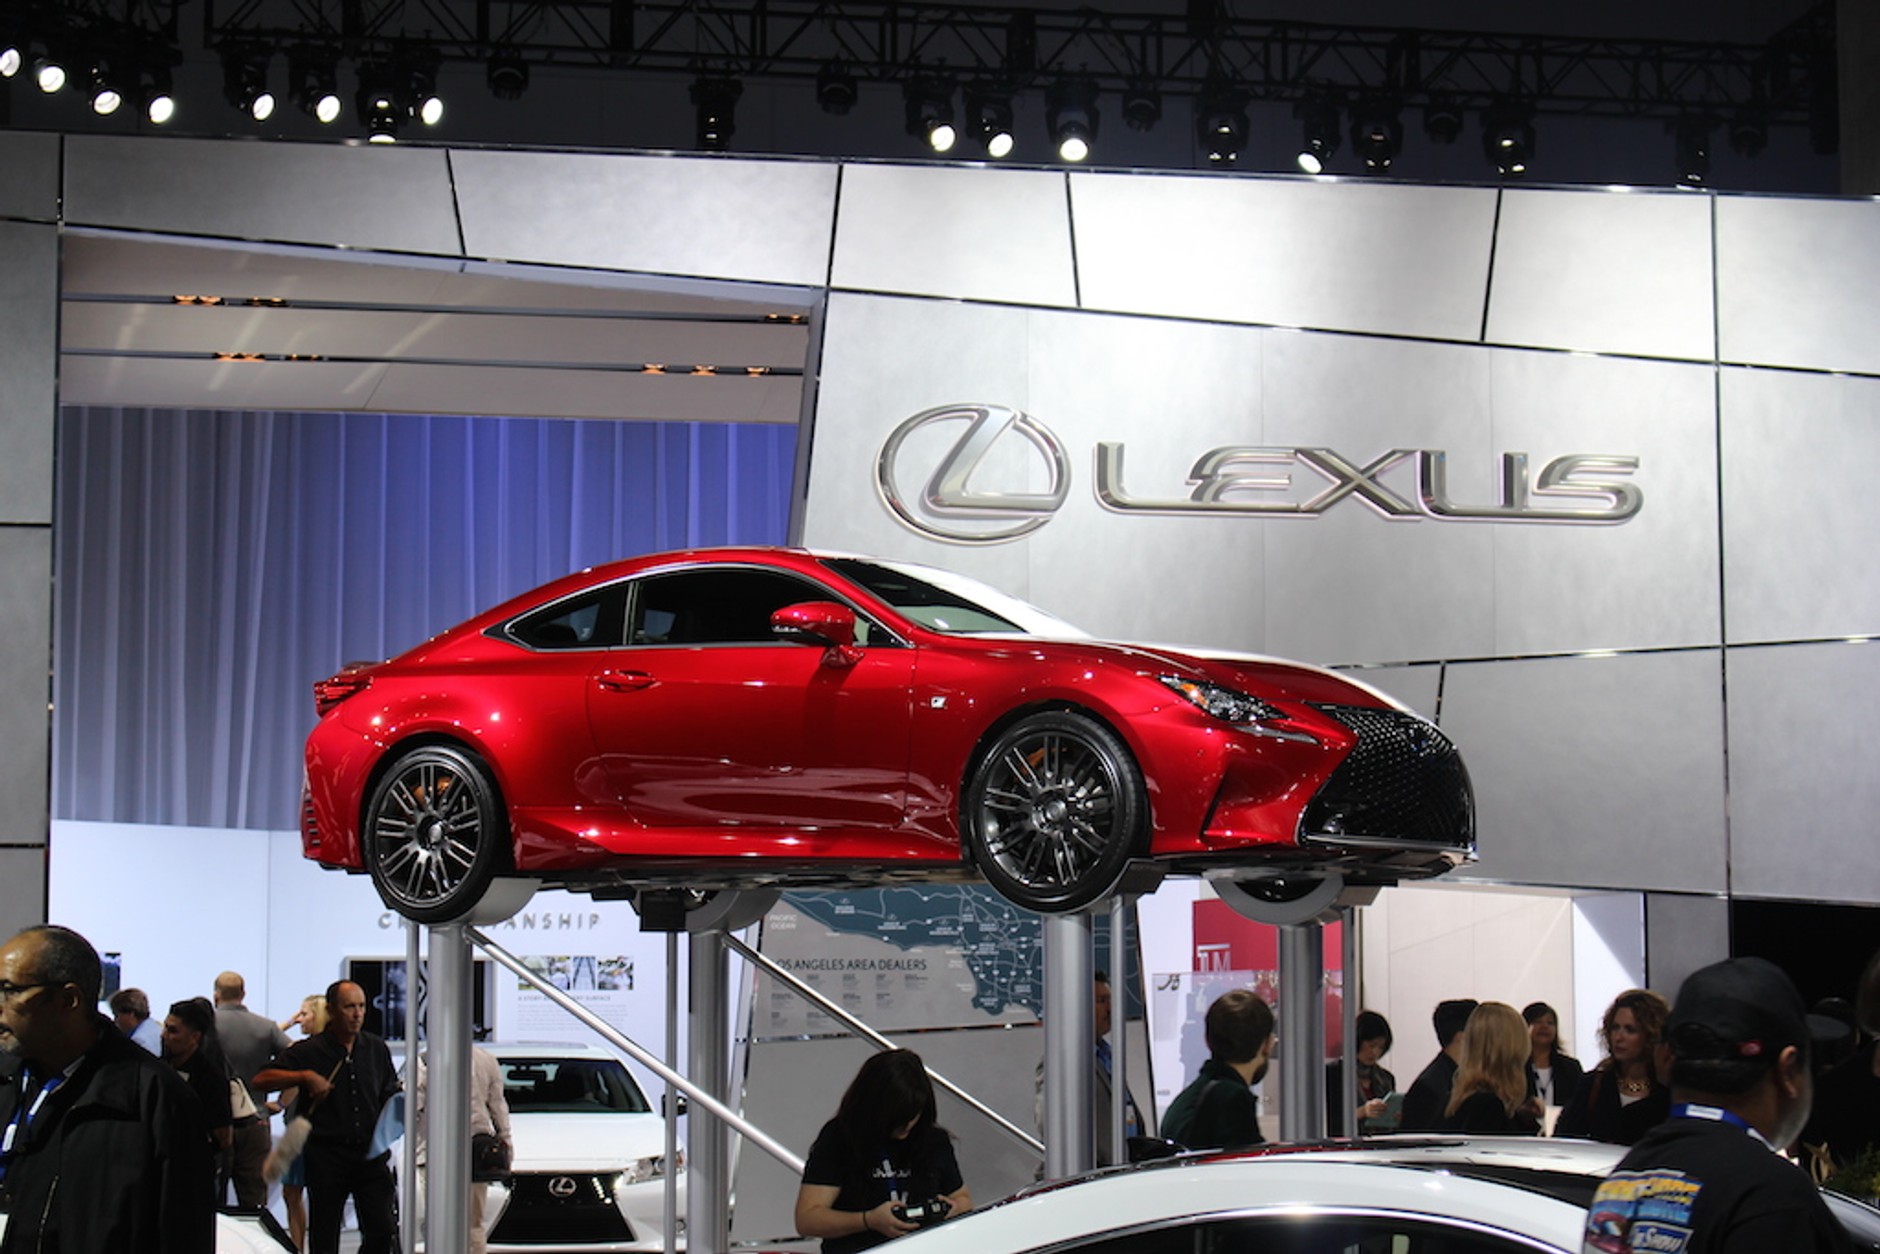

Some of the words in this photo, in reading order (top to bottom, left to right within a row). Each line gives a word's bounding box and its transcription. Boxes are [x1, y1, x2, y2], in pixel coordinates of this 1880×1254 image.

[1092, 440, 1645, 526] LEXUS
[770, 922, 797, 930] OCEAN
[772, 957, 792, 971] OS
[793, 958, 845, 971] ANGELES
[847, 958, 877, 971] AREA
[878, 957, 927, 971] DEALERS
